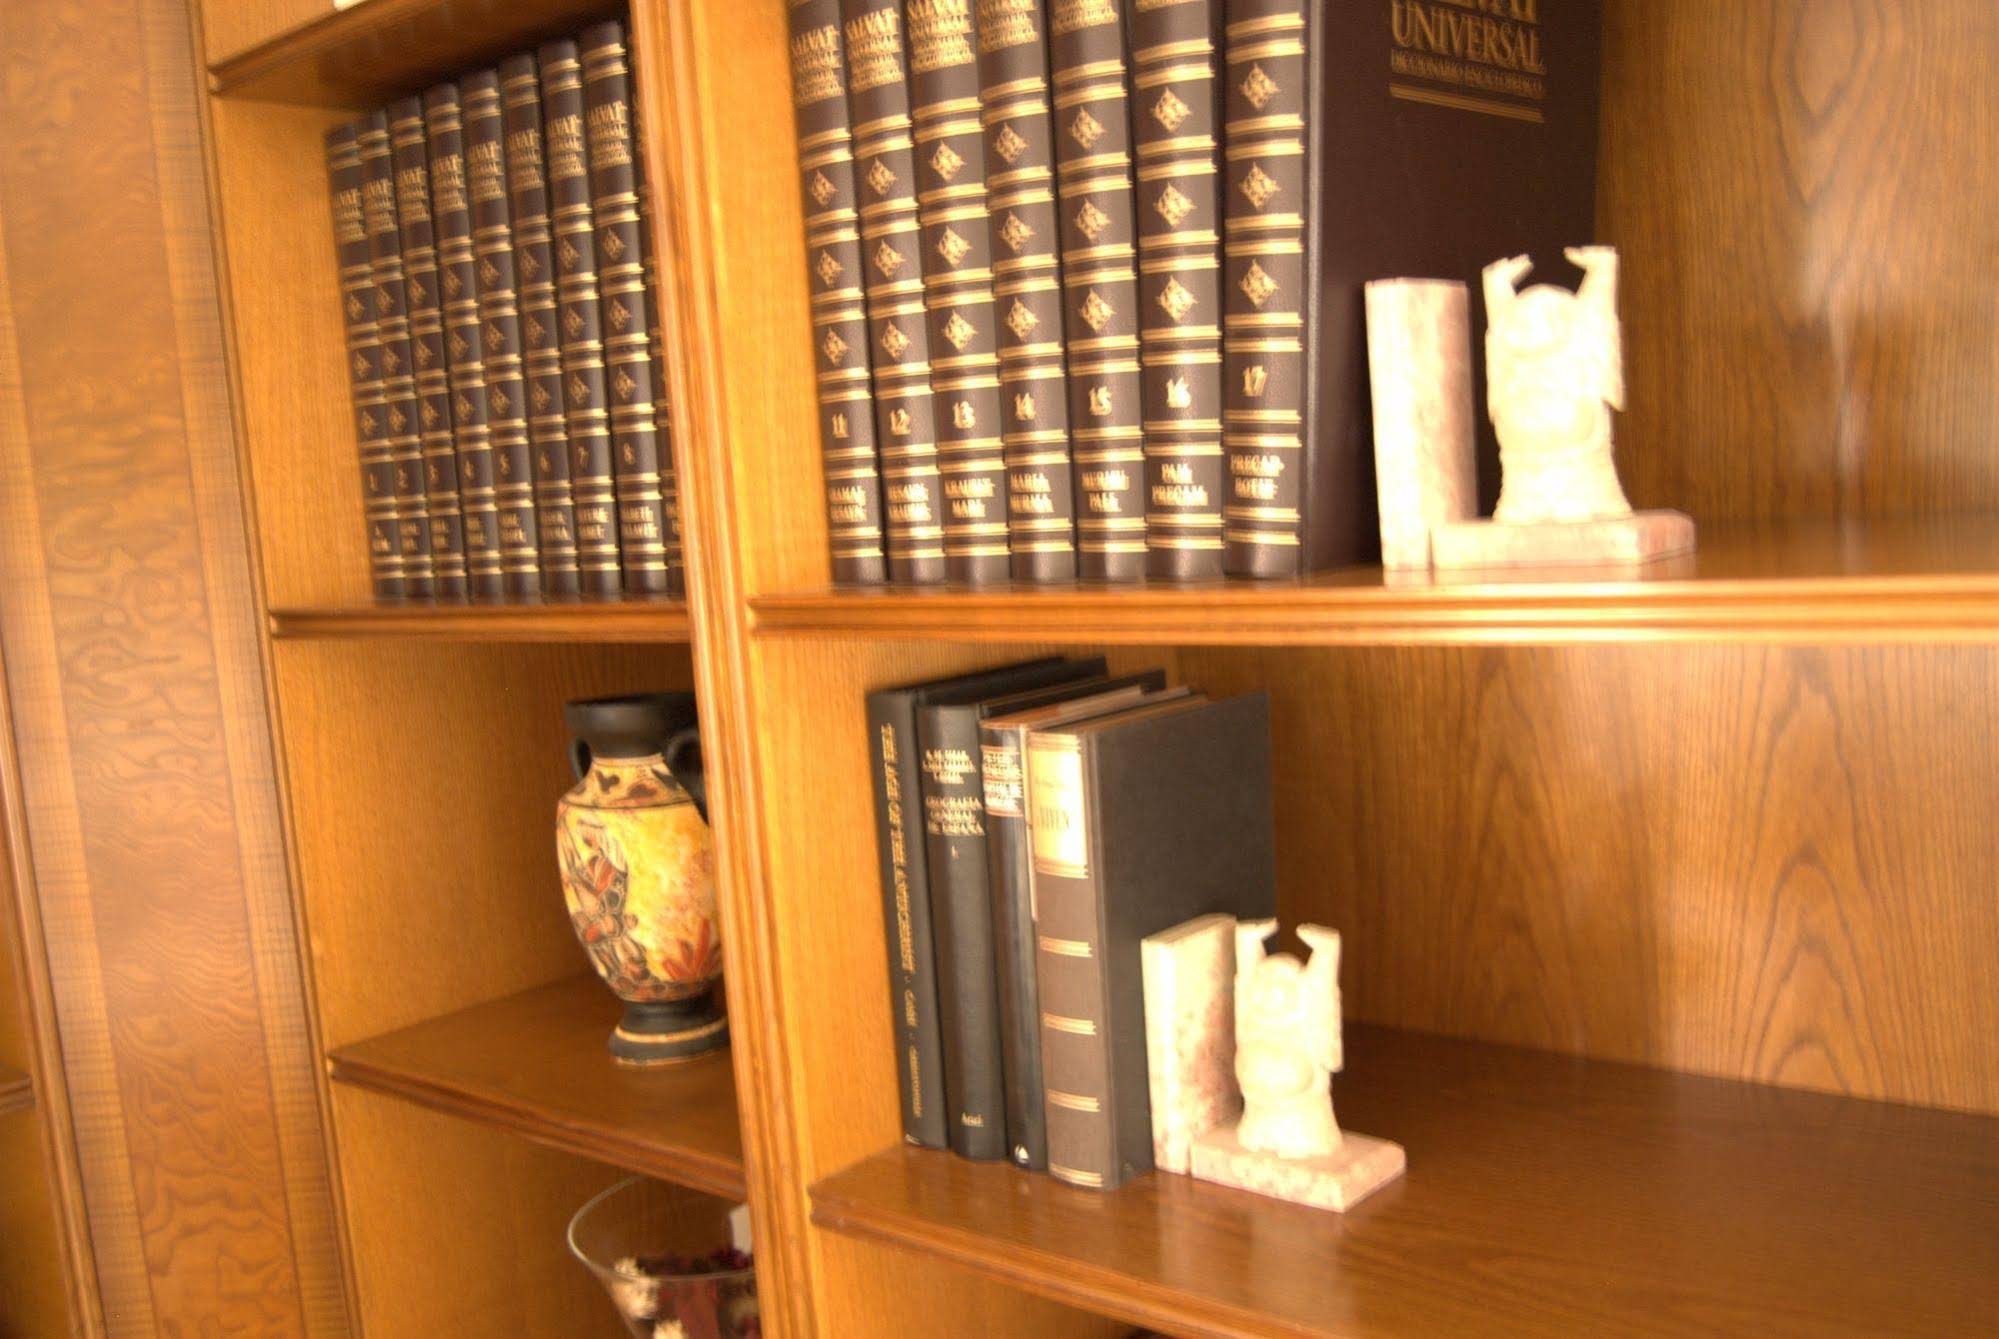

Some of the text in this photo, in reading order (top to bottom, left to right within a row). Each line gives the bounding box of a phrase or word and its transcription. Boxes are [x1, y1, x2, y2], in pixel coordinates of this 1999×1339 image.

[1391, 2, 1547, 75] UNIVERSAL
[1165, 376, 1192, 408] 16
[1243, 365, 1268, 397] 17
[953, 401, 975, 429] 13
[1015, 393, 1036, 420] 14
[1089, 386, 1112, 416] 15
[832, 414, 849, 438] 11
[889, 408, 911, 436] 12
